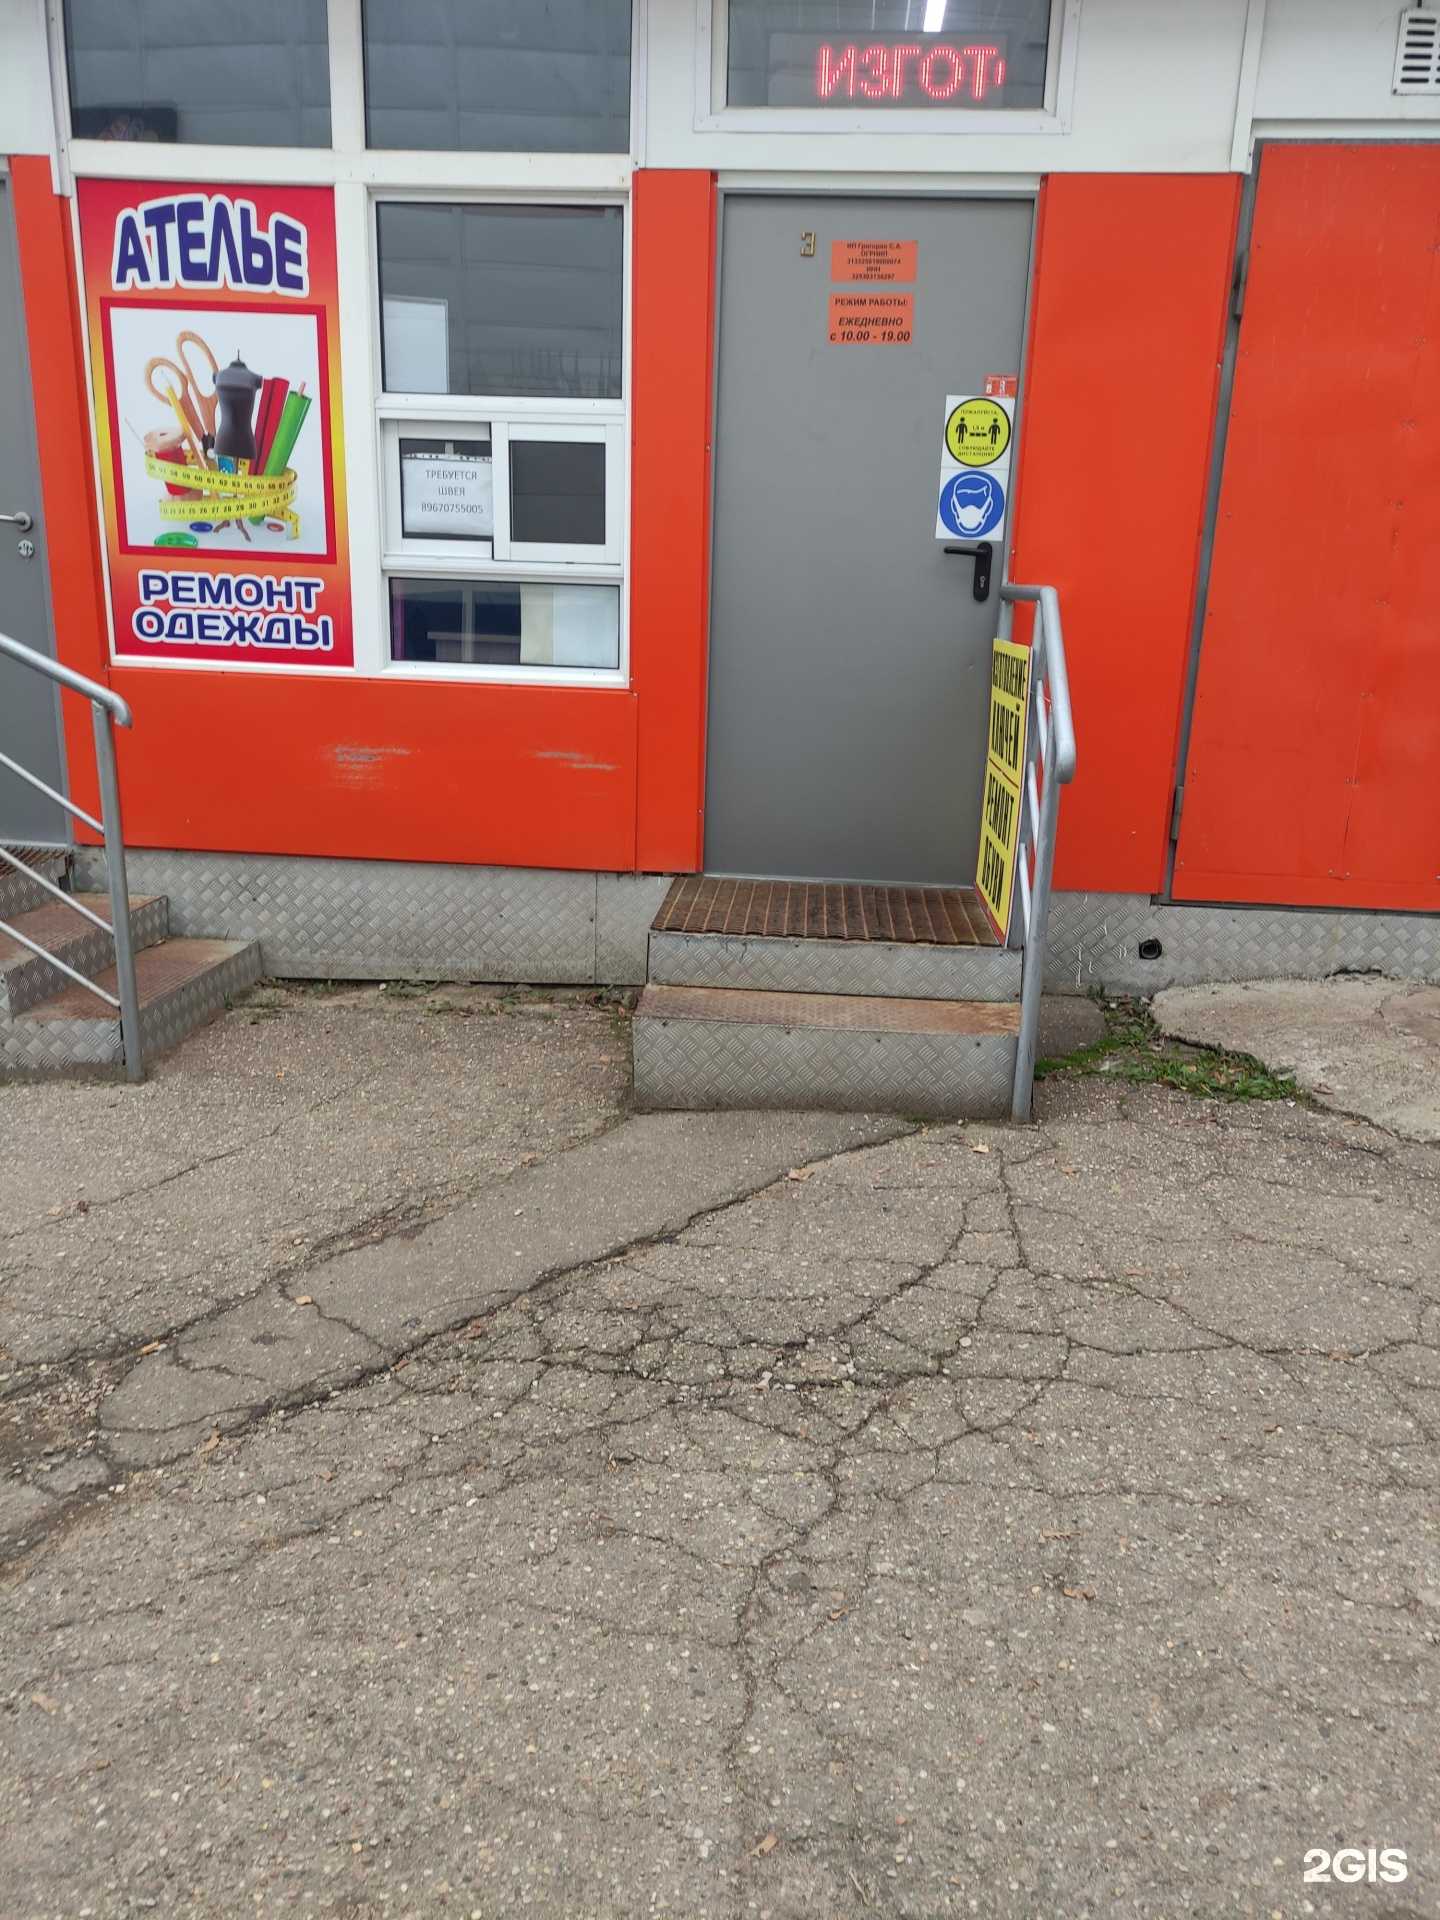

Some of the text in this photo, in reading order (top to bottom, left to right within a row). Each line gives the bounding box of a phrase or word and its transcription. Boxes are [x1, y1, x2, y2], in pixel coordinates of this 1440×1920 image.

[817, 46, 1004, 98] ИЗГОТ
[114, 199, 305, 291] АТЕЛЬЕ
[834, 298, 867, 306] РЕЖИМ
[838, 317, 904, 328] ЕЖЕДНЕВНО
[841, 331, 870, 342] 10.00
[881, 331, 911, 342] 19.00
[425, 469, 478, 480] ТРЕБУЕТСЯ
[438, 486, 466, 497] ШВЕЯ
[141, 574, 321, 609] РЕМОНТ
[135, 610, 331, 647] ОДЕЖДЫ
[991, 700, 1021, 771] КЛЮЧЕЙ
[985, 772, 1014, 851] РЕМОНТ
[981, 835, 1005, 913] ОБУВИ
